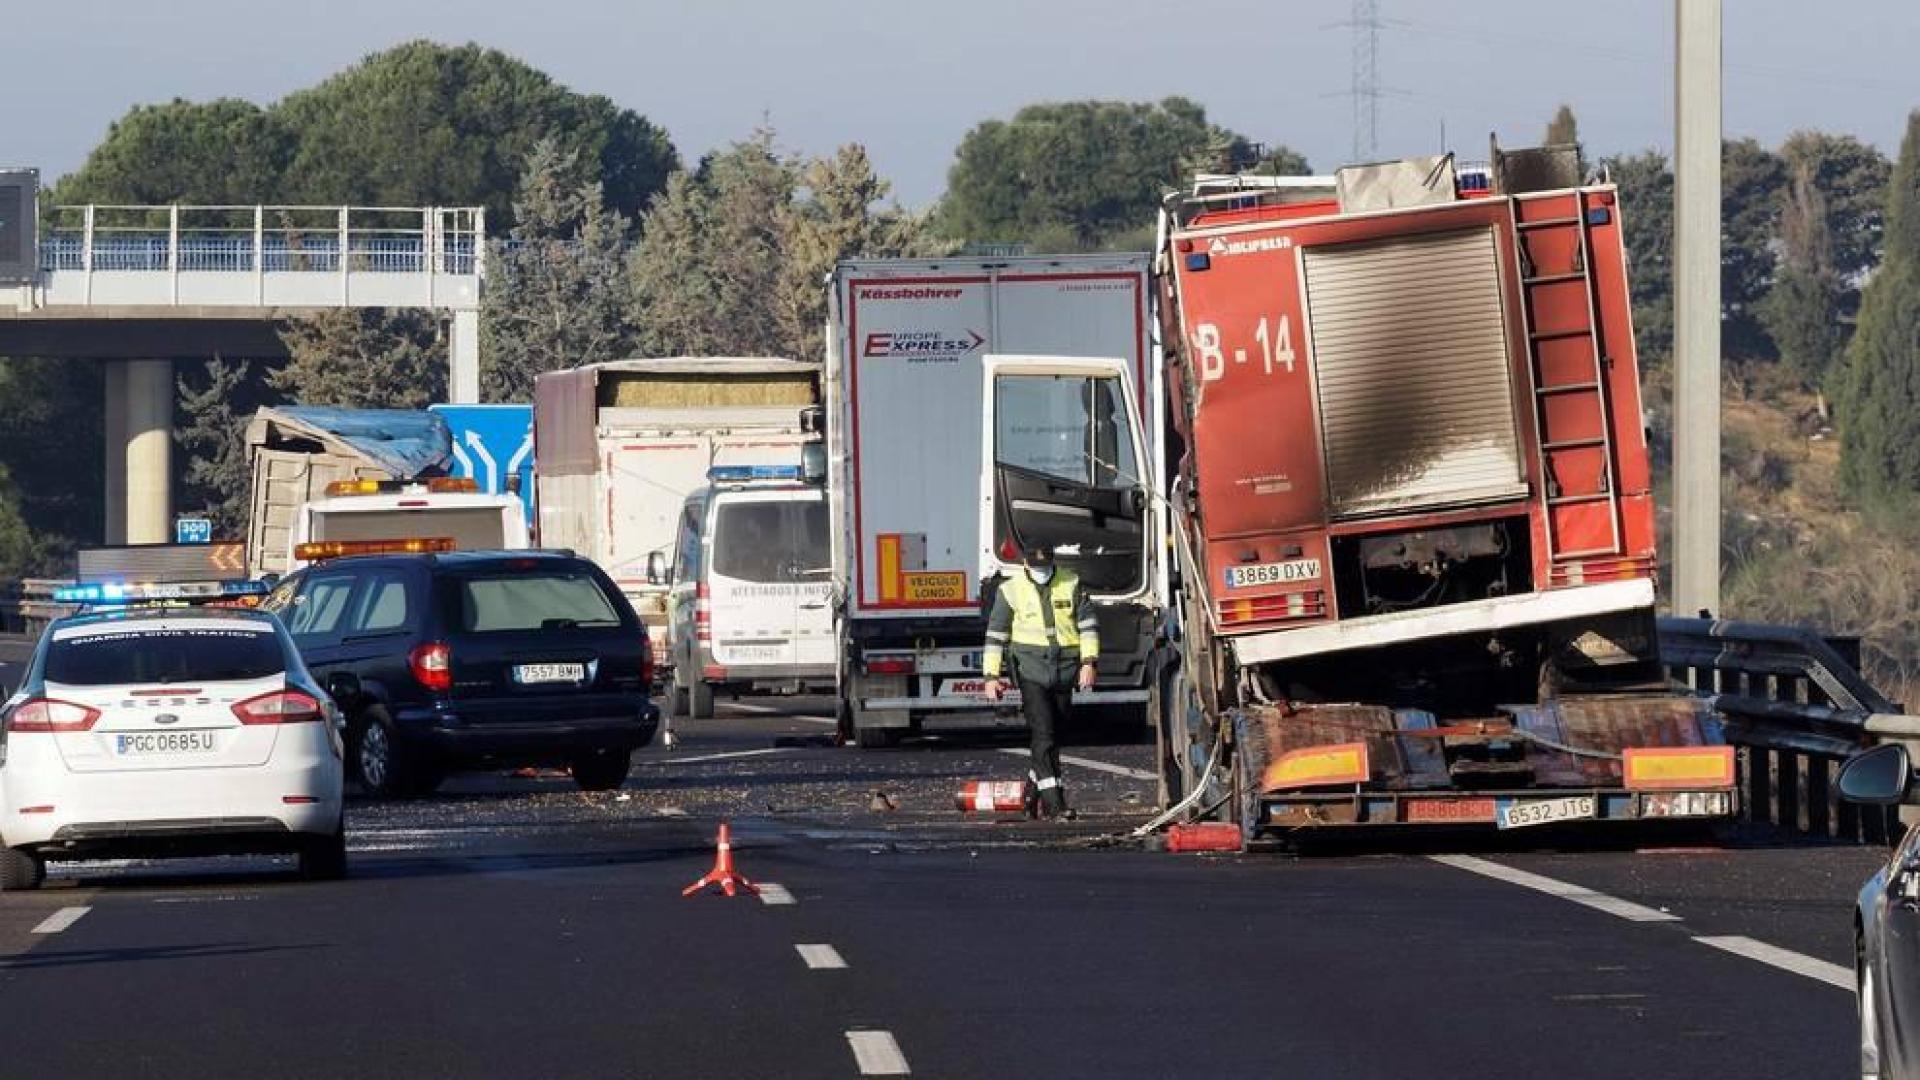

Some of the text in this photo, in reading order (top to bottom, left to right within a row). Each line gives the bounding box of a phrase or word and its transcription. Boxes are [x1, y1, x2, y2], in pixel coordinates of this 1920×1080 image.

[1256, 313, 1295, 375] 14
[1236, 562, 1315, 585] 3869 DXV
[914, 588, 955, 598] LONGO
[125, 731, 214, 752] PGC 0685 U
[1508, 800, 1592, 825] 6532 JTG
